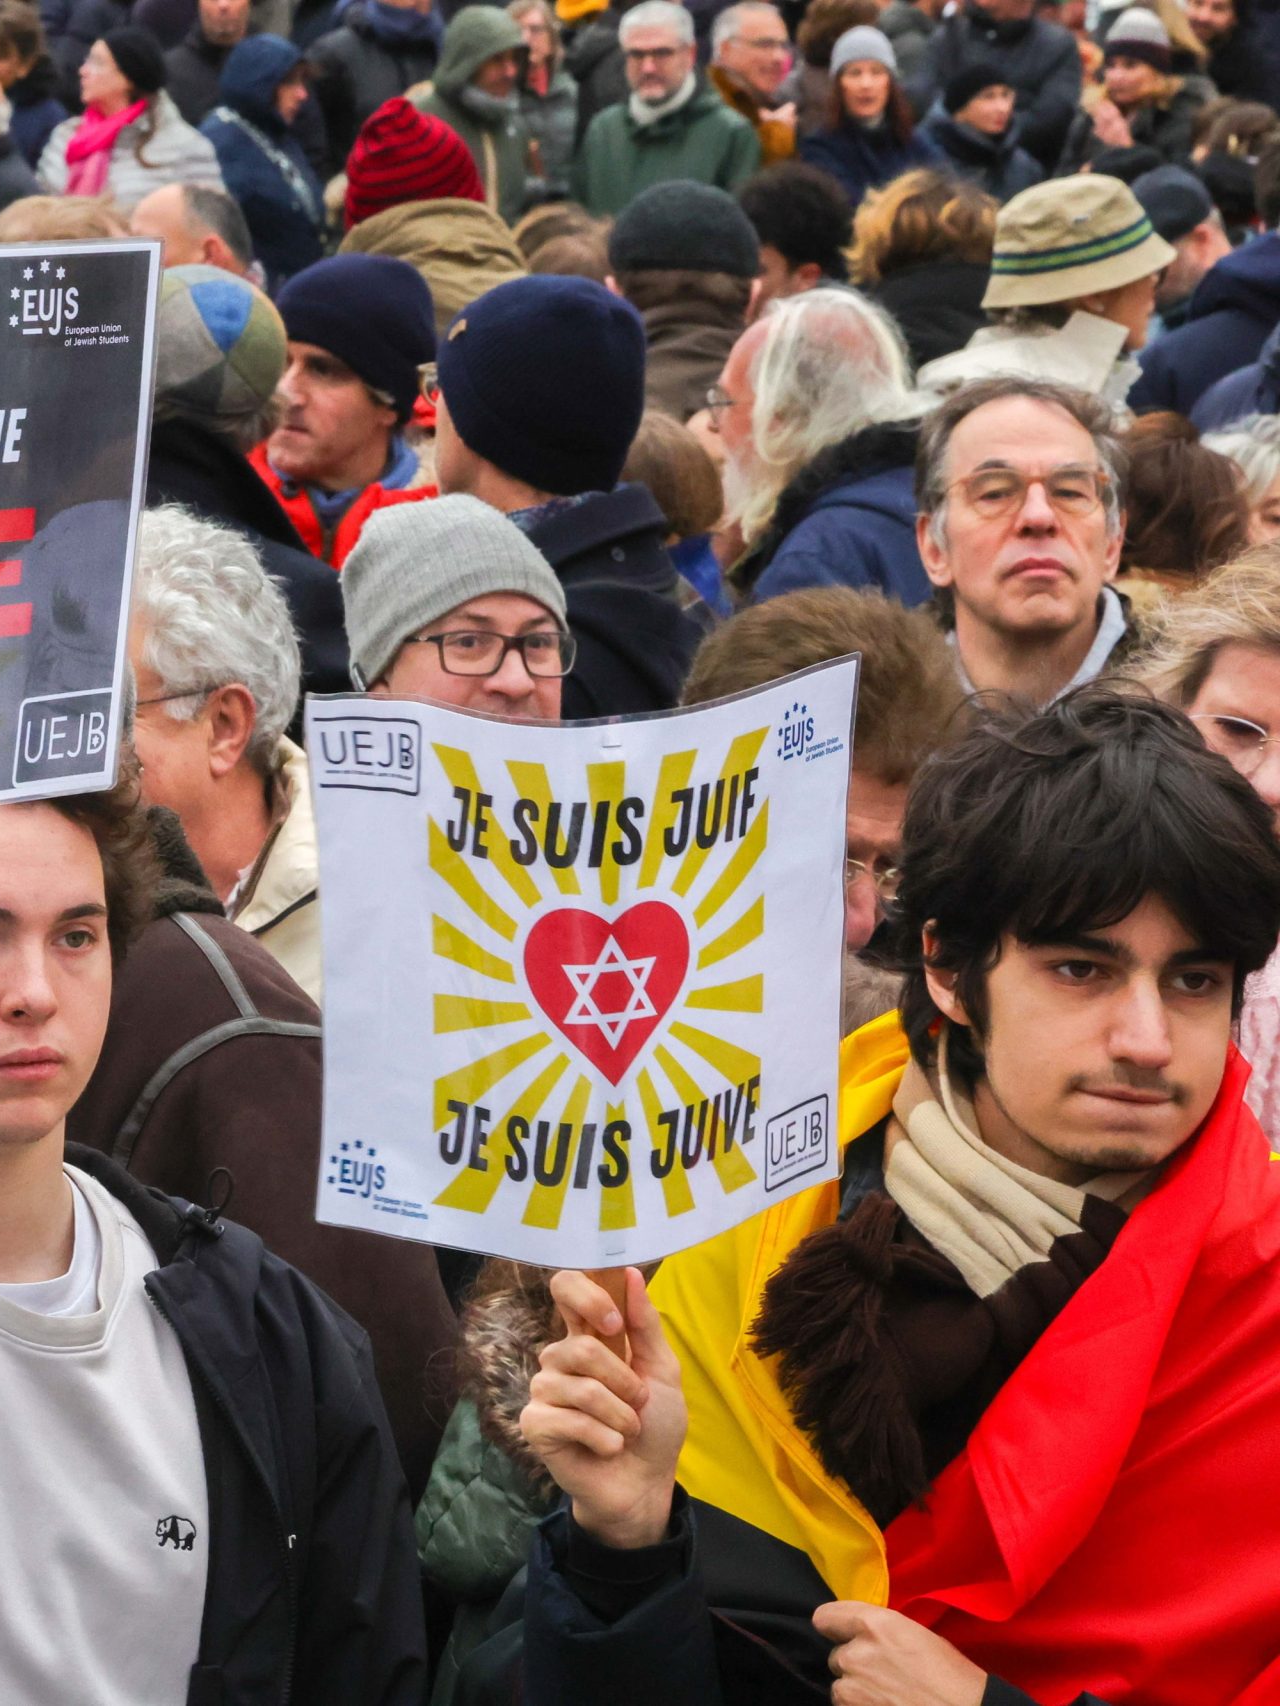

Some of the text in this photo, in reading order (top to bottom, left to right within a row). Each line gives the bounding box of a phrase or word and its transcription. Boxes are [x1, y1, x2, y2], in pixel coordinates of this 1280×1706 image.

[22, 286, 80, 336] EUJS
[65, 324, 122, 335] European Union
[64, 335, 130, 346] of Jewish Students
[24, 711, 106, 764] UEJB
[320, 730, 414, 770] UEJB
[783, 717, 814, 756] EUJS
[447, 767, 759, 869] JE SUIS JUIF
[439, 1074, 761, 1189] JE SUIS JUIVE
[770, 1111, 823, 1166] UEJB
[339, 1158, 386, 1199] EUJS
